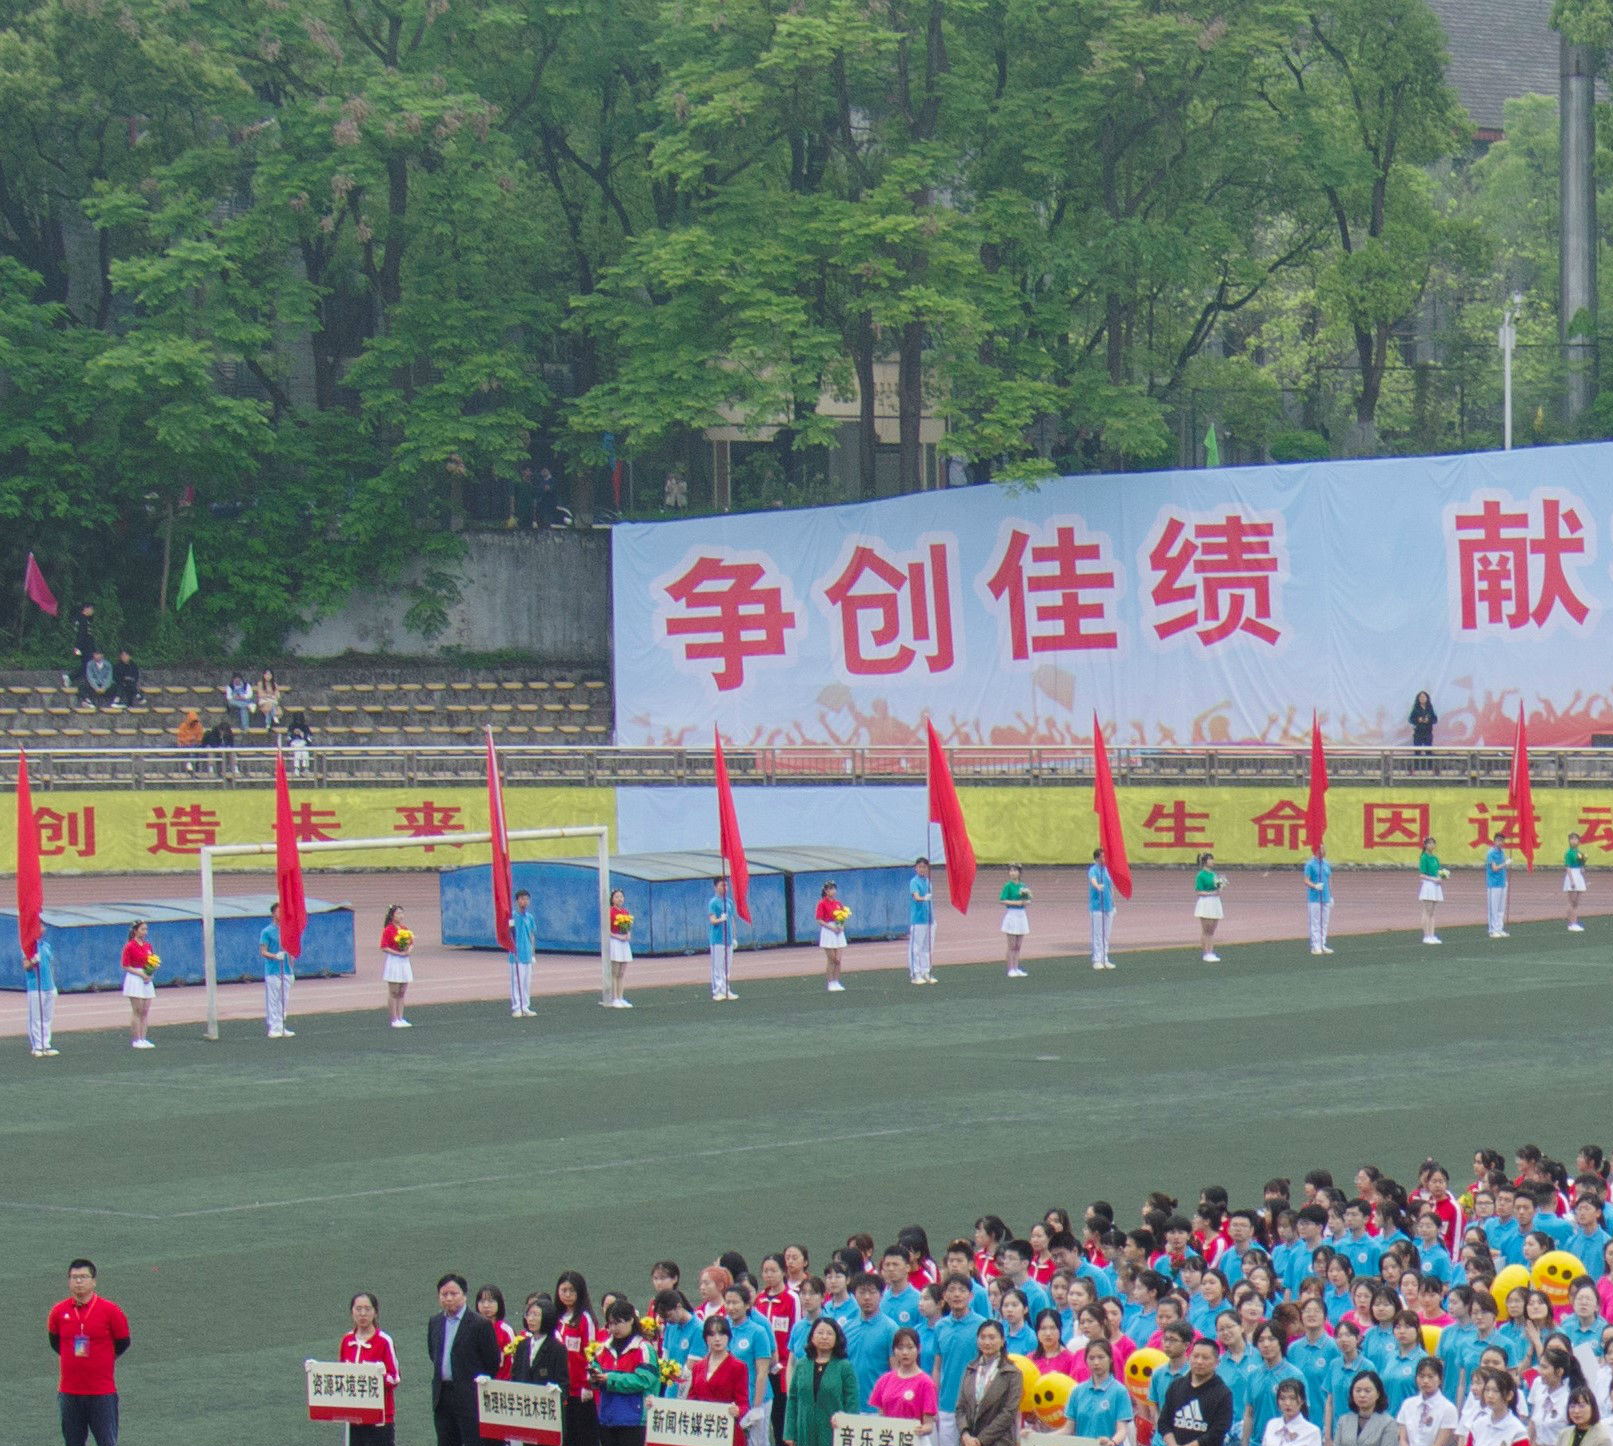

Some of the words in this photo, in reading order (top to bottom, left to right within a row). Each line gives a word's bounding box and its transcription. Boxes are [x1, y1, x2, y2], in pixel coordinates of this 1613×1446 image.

[664, 513, 1283, 692] 争创佳绩
[33, 800, 467, 857] 创造未来
[312, 1371, 380, 1399] 资源环境学院
[483, 1391, 557, 1422] 物理科学与技术学院
[652, 1408, 730, 1440] 新闻传媒学院
